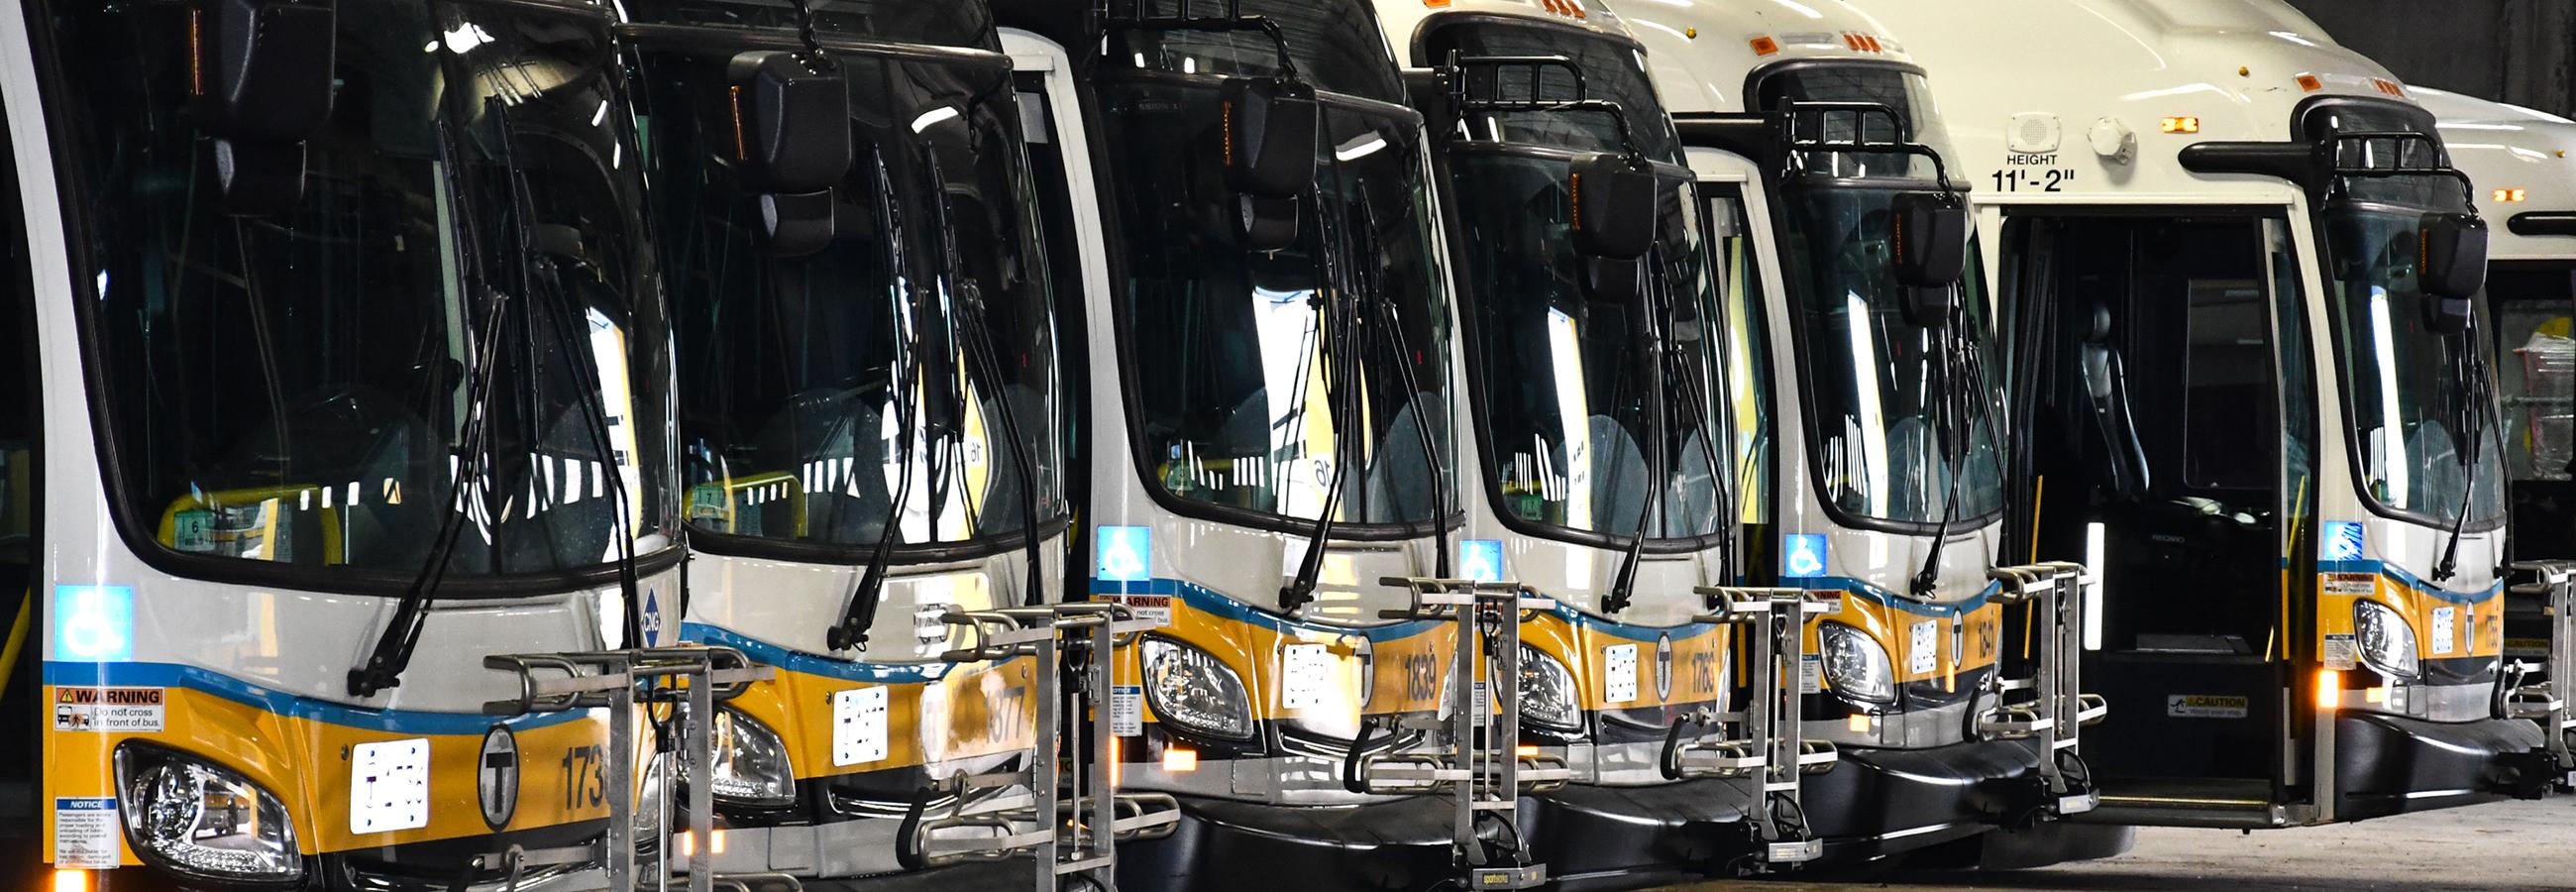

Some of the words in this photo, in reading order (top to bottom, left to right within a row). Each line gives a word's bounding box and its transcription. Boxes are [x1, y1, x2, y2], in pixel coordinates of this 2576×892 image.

[2006, 155, 2058, 166] HEIGHT
[191, 521, 198, 533] 6
[644, 612, 659, 631] CNG
[1953, 624, 1962, 660] T
[1405, 653, 1437, 702] 1839
[1659, 651, 1669, 691] T
[76, 690, 160, 704] WARNING
[2196, 697, 2246, 707] CAUTION
[111, 708, 127, 717] not
[984, 686, 1026, 744] 1877
[106, 718, 129, 726] front
[131, 718, 141, 726] of
[485, 751, 513, 814] T
[70, 800, 103, 809] NOTICE
